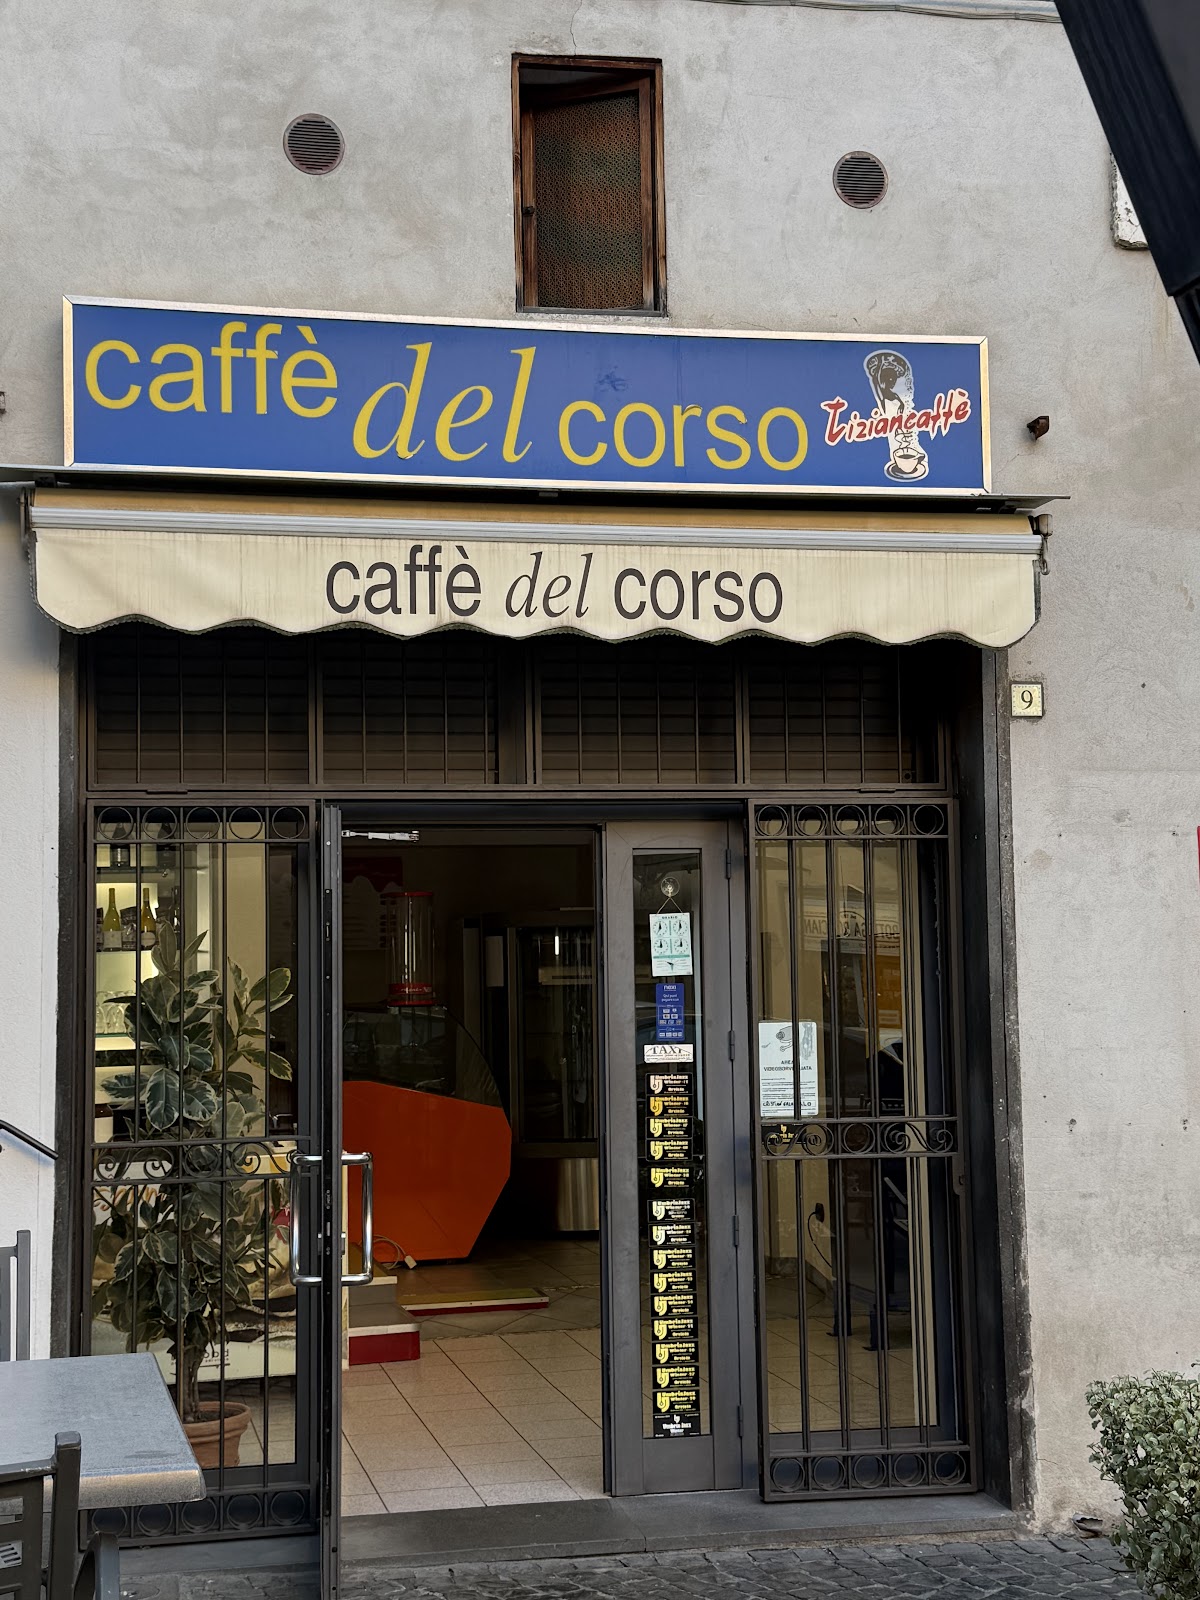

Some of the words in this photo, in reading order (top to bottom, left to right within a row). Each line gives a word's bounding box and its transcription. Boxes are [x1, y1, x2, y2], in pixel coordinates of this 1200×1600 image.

[85, 320, 338, 418] caffè
[352, 341, 537, 464] del
[558, 400, 808, 471] corso
[326, 544, 482, 618] caffè
[505, 552, 594, 619] del
[614, 567, 784, 624] corso
[1020, 689, 1034, 710] 9
